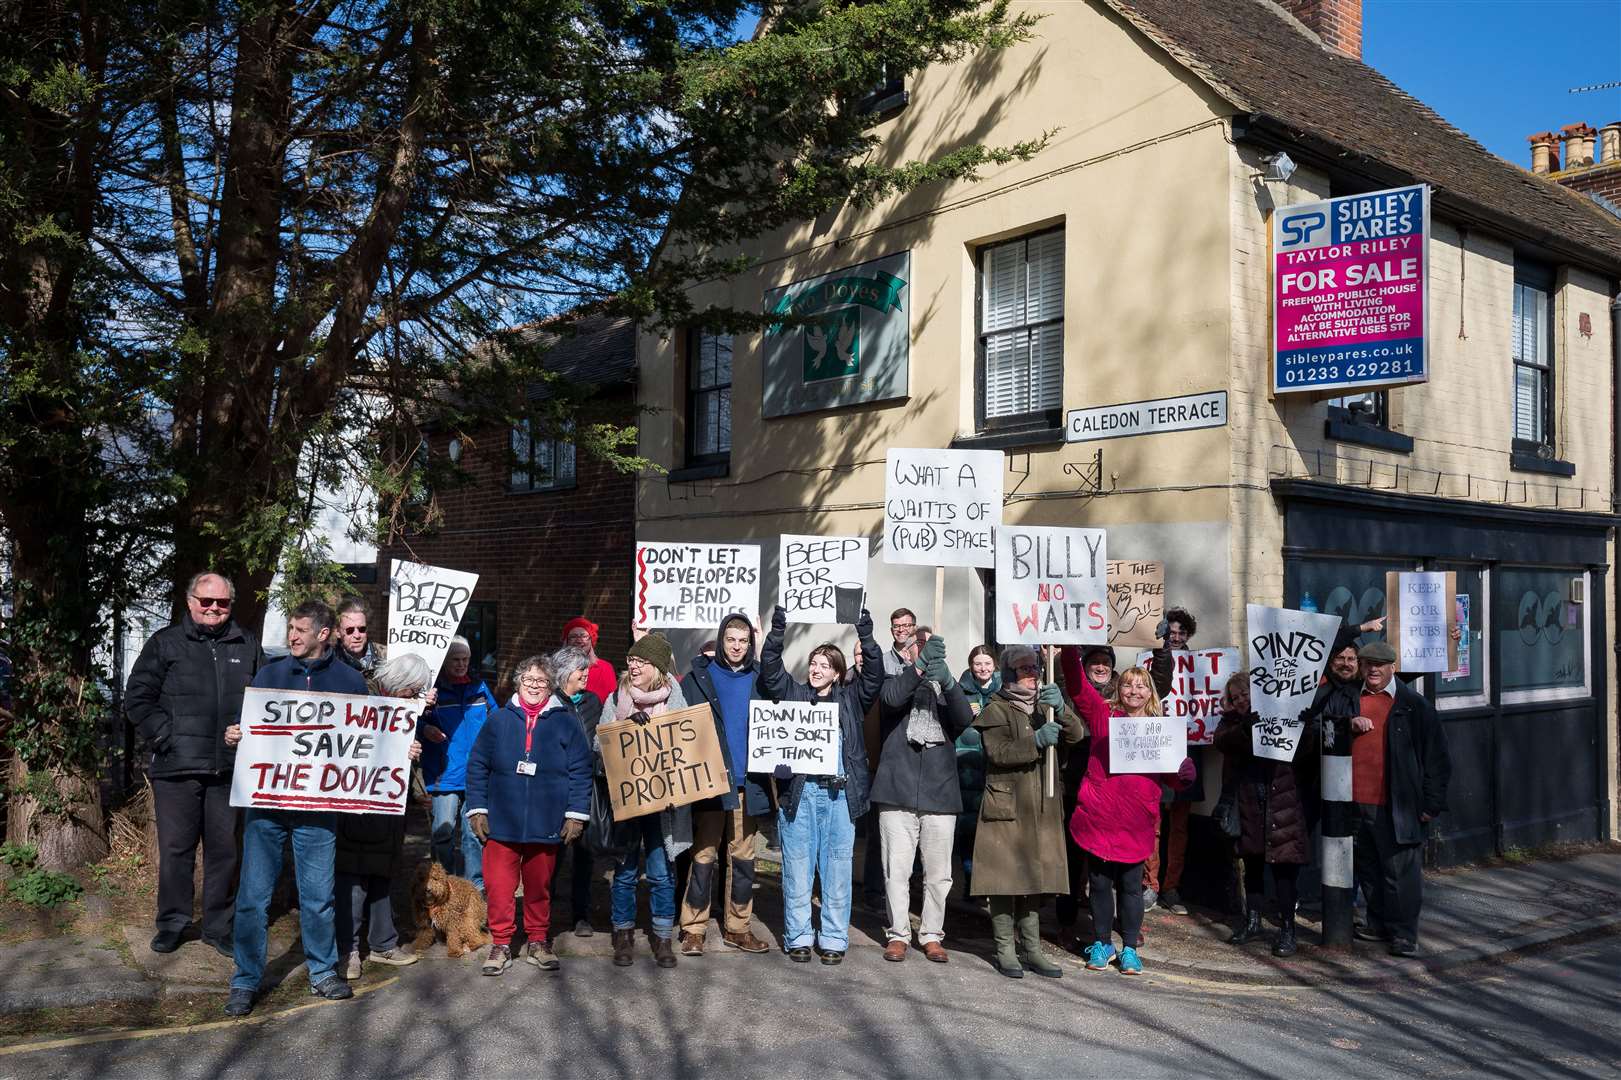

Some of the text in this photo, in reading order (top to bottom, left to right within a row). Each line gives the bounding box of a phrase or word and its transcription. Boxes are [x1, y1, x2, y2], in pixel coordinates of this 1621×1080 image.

[1338, 193, 1415, 221] SIBLEY
[1340, 214, 1413, 242] PARES
[1287, 237, 1411, 264] TAYLOR RILEY
[1282, 258, 1417, 294] FOR SALE
[1282, 284, 1417, 307] FREEHOLD PUBLIC HOUSE
[1313, 298, 1383, 312] WITH LIVING
[1294, 323, 1317, 333] MAY
[1319, 321, 1332, 331] BE
[1334, 315, 1386, 329] SUITABLE
[1389, 313, 1411, 322] FOR
[1301, 305, 1396, 323] ACCOMMODATION
[1287, 321, 1410, 342] ALTERNATIVE USES STP
[1286, 344, 1413, 365] sibleypares.co.uk
[1286, 360, 1413, 383] 01233 629281
[1073, 400, 1220, 433] CALEDON TERRACE
[895, 459, 976, 488] WHAT A
[888, 499, 990, 520] WAITTS OF
[893, 523, 994, 553] (PUB) SPACE!
[645, 546, 741, 564] DON'T LET
[786, 540, 861, 568] BEEP
[1012, 534, 1102, 580] BILLY
[653, 567, 757, 584] DEVELOPERS
[787, 567, 832, 587] FOR
[1107, 562, 1157, 576] ET THE
[680, 587, 731, 604] BEND
[1038, 583, 1065, 602] NO
[1134, 583, 1164, 595] FREE
[1408, 583, 1441, 593] KEEP
[396, 581, 471, 622] BEER
[785, 586, 835, 613] BEER
[648, 605, 686, 621] THE
[1012, 602, 1105, 635] WAITS
[1410, 605, 1440, 616] OUR
[403, 614, 452, 630] BEFORE
[1410, 626, 1441, 637] PUBS
[389, 628, 450, 649] BEDSITS
[1252, 631, 1326, 662] PINTS
[1404, 647, 1445, 658] ALIVE!
[1274, 658, 1298, 668] FOR
[1274, 668, 1297, 678] THE
[1171, 676, 1221, 696] ILL
[1249, 666, 1319, 698] PEOPLE!
[753, 707, 833, 726] DOWN WITH
[1175, 697, 1222, 717] DOVE
[261, 701, 416, 734] STOP WATES
[1281, 718, 1299, 728] THE
[619, 719, 697, 758] PINTS
[752, 726, 835, 743] THIS SORT
[1119, 722, 1137, 736] SAY
[1255, 724, 1283, 736] TWO
[292, 731, 374, 759] SAVE
[1261, 735, 1293, 751] DOVES
[631, 747, 686, 777] OVER
[752, 746, 823, 762] OF THING
[1125, 750, 1161, 761] OF USE
[250, 763, 406, 800] THE DOVES
[620, 762, 713, 806] PROFIT!
